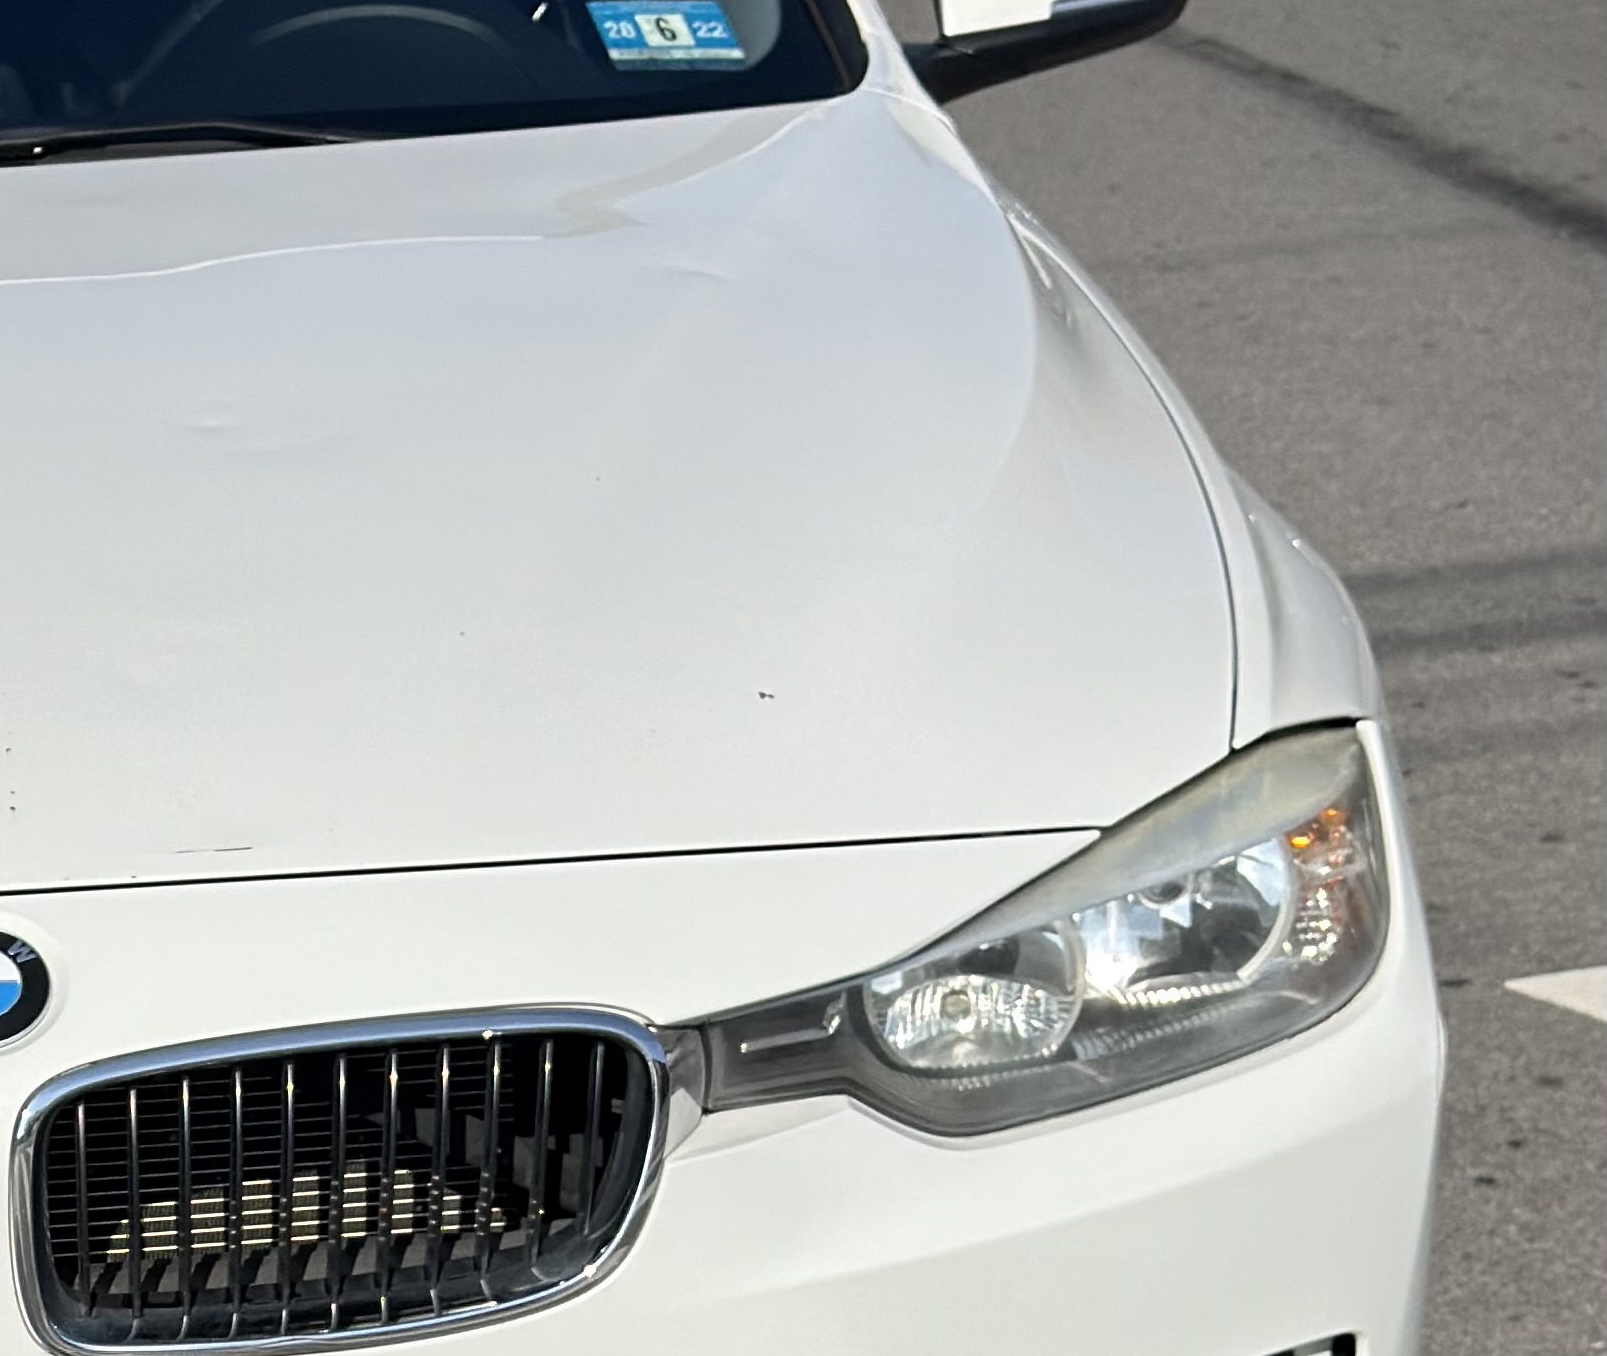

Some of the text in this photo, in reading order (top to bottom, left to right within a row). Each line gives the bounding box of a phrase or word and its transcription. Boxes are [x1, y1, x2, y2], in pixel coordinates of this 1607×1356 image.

[603, 17, 728, 42] 20 6 22
